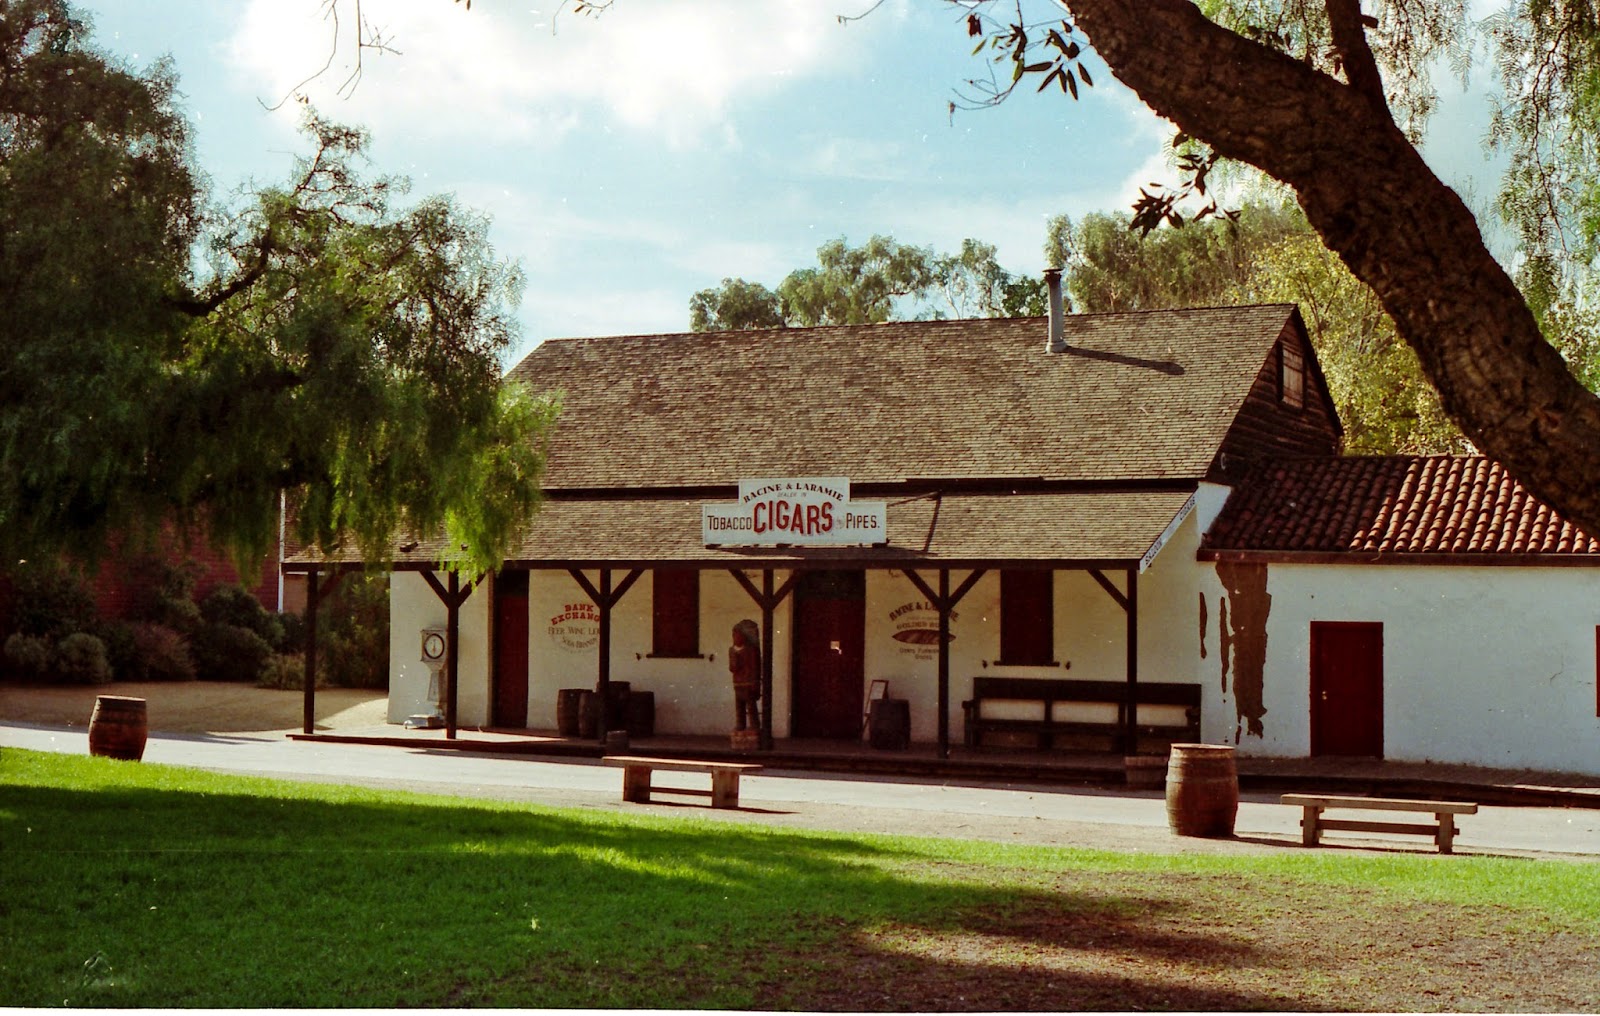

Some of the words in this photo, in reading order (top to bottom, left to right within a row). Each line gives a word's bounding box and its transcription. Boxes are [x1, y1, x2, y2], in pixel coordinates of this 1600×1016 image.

[743, 484, 782, 503] RACINE
[796, 483, 844, 501] LARAMIE
[753, 500, 833, 535] CIGARS
[564, 603, 594, 612] BANK
[551, 612, 600, 625] EXCHANG
